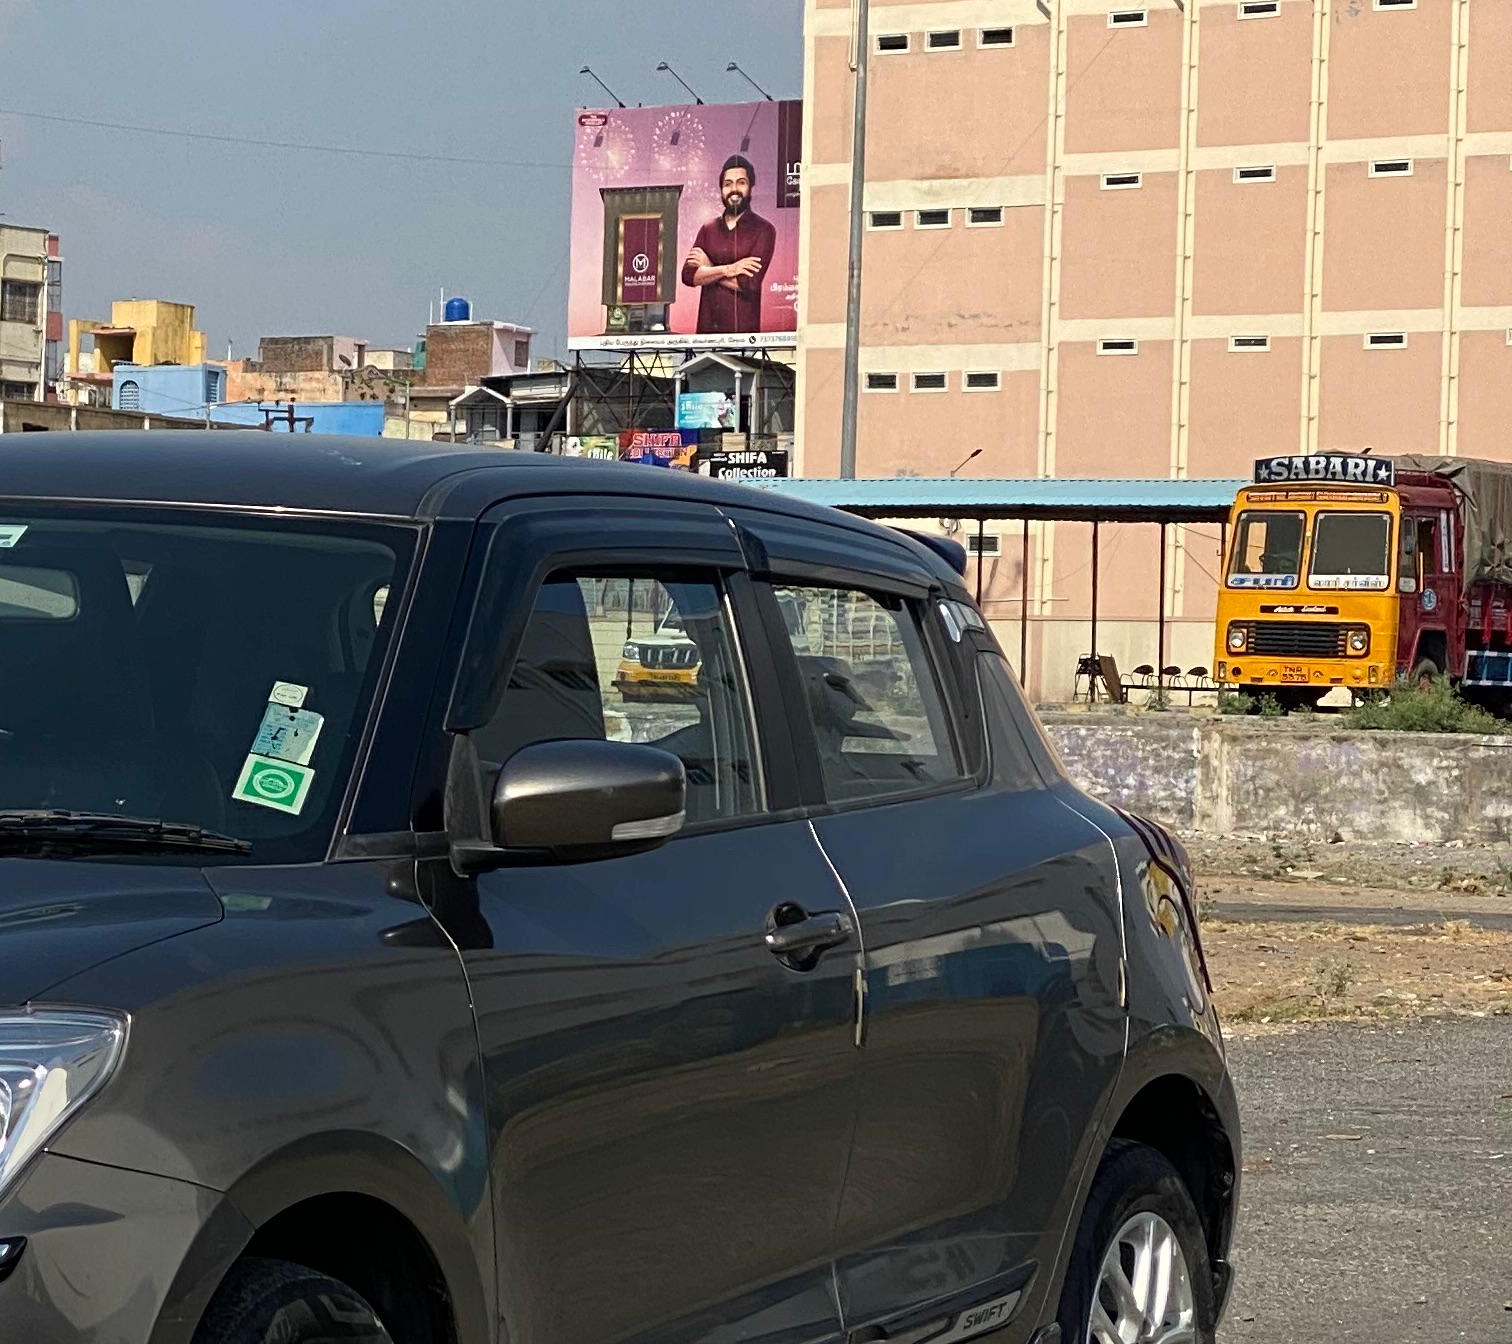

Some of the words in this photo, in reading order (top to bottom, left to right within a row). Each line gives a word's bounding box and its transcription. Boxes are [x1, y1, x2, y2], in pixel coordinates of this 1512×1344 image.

[624, 275, 656, 283] MALABAR
[728, 452, 768, 464] SHIFA
[718, 466, 777, 480] Collection
[1270, 456, 1377, 482] SABARI
[963, 1301, 1008, 1330] SWIFT
